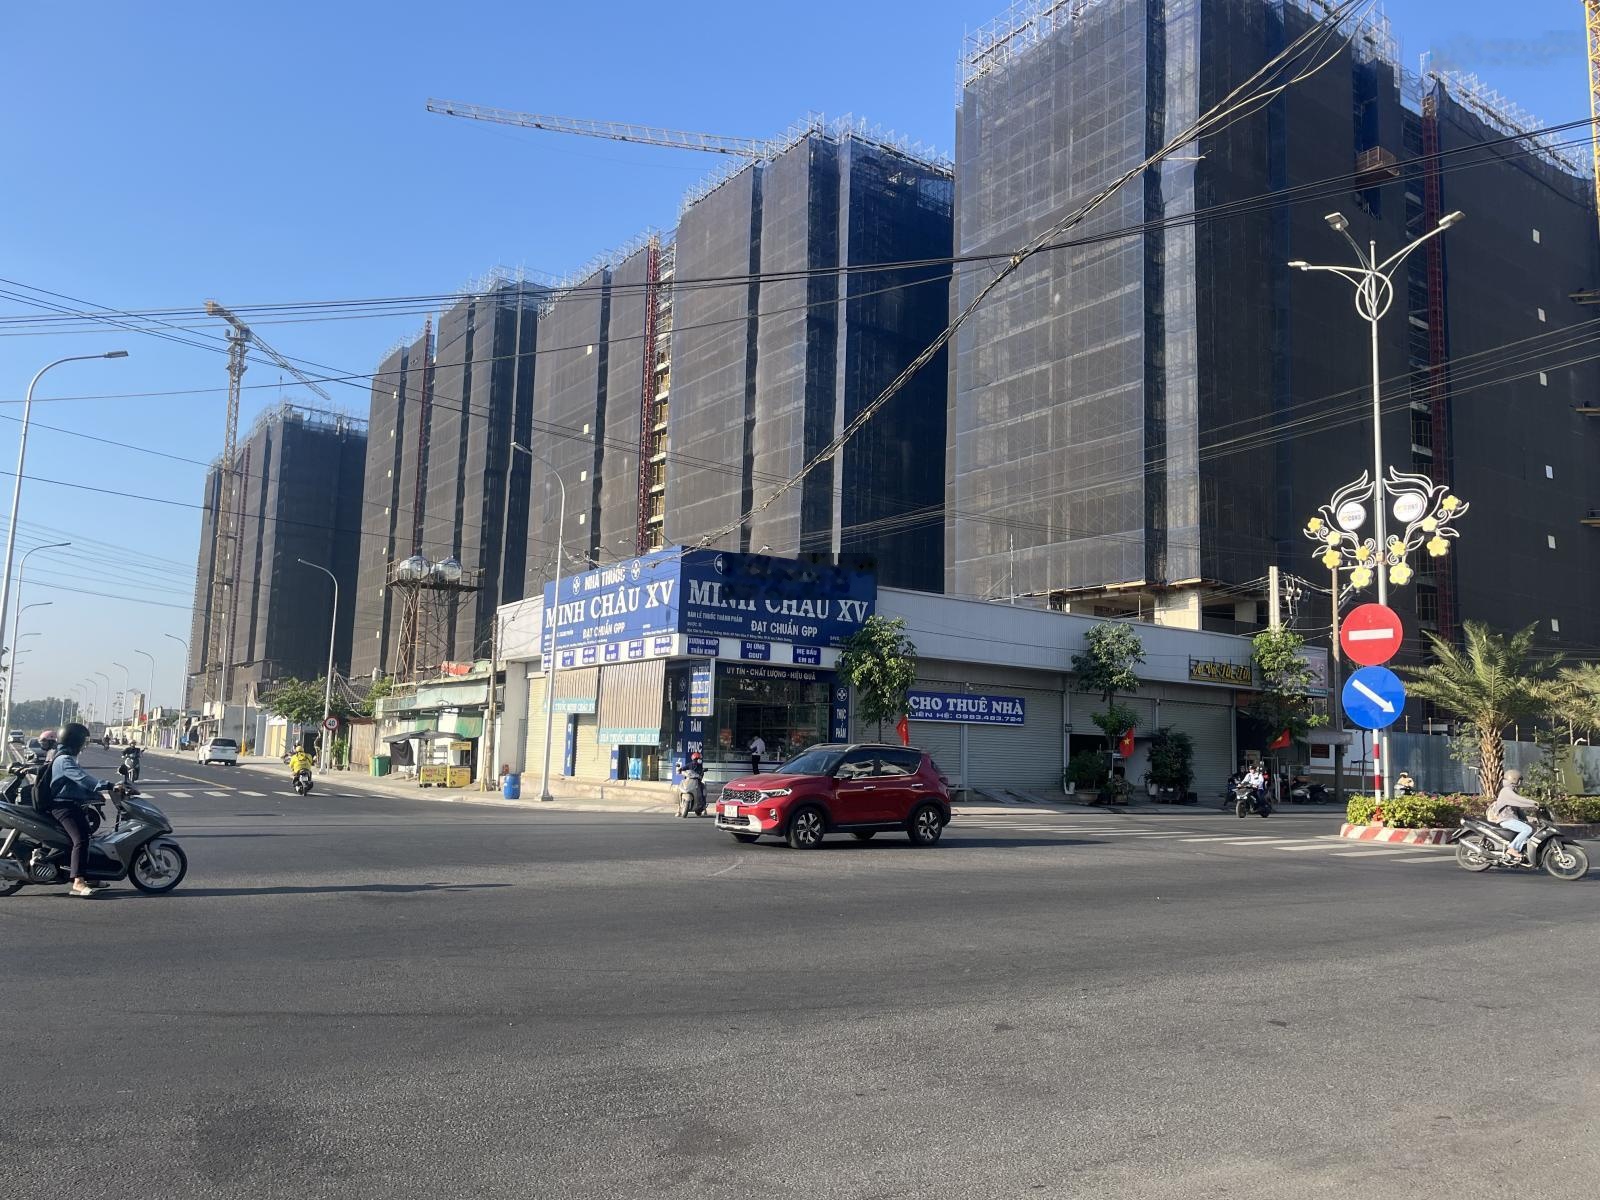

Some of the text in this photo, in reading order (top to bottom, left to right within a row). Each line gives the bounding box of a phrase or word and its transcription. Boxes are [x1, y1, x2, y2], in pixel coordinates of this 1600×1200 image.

[584, 564, 626, 590] NHÀ THUỐC
[545, 579, 675, 628] MINH CHÂU XV
[836, 600, 869, 624] XV
[751, 620, 767, 635] ĐẠT
[770, 618, 799, 636] CHUẨN
[802, 625, 818, 638] GPP
[750, 666, 767, 677] CHẤT
[909, 696, 1023, 714] CHO THUÊ NHÀ
